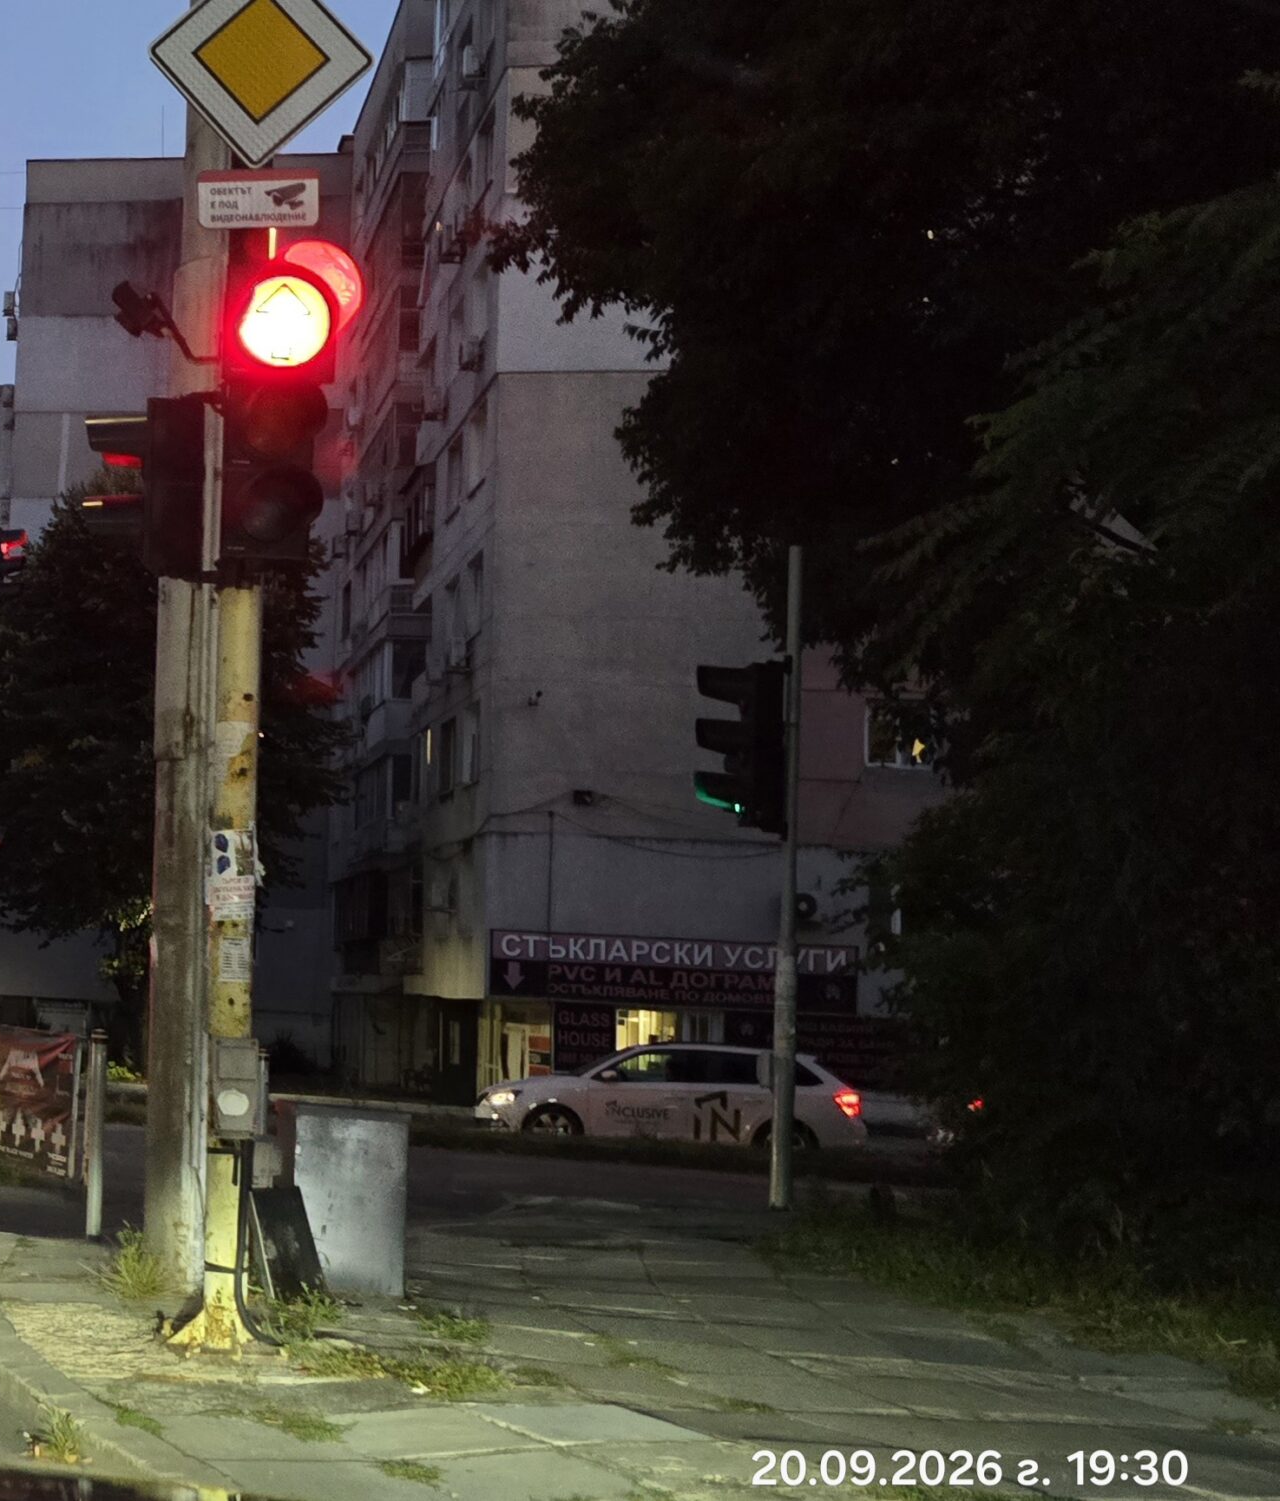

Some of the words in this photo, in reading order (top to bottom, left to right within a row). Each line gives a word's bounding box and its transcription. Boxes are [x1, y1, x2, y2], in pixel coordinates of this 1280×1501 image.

[210, 186, 252, 196] ОБЕКТЪТ
[210, 201, 216, 209] Е
[218, 201, 238, 210] ПОД
[210, 212, 307, 223] ВИДЕОНАБЛЮДЕНИЕ
[501, 933, 714, 967] СТЪКЛАРСКИ
[548, 963, 595, 982] PVC
[604, 966, 622, 983] И
[630, 968, 663, 986] AL
[670, 970, 776, 990] ДОГРАМ
[547, 982, 671, 1000] ОСТЪКЛЯВАНЕ
[675, 990, 699, 1001] ПО
[558, 1010, 610, 1028] GLASS
[558, 1030, 611, 1048] HOUSE
